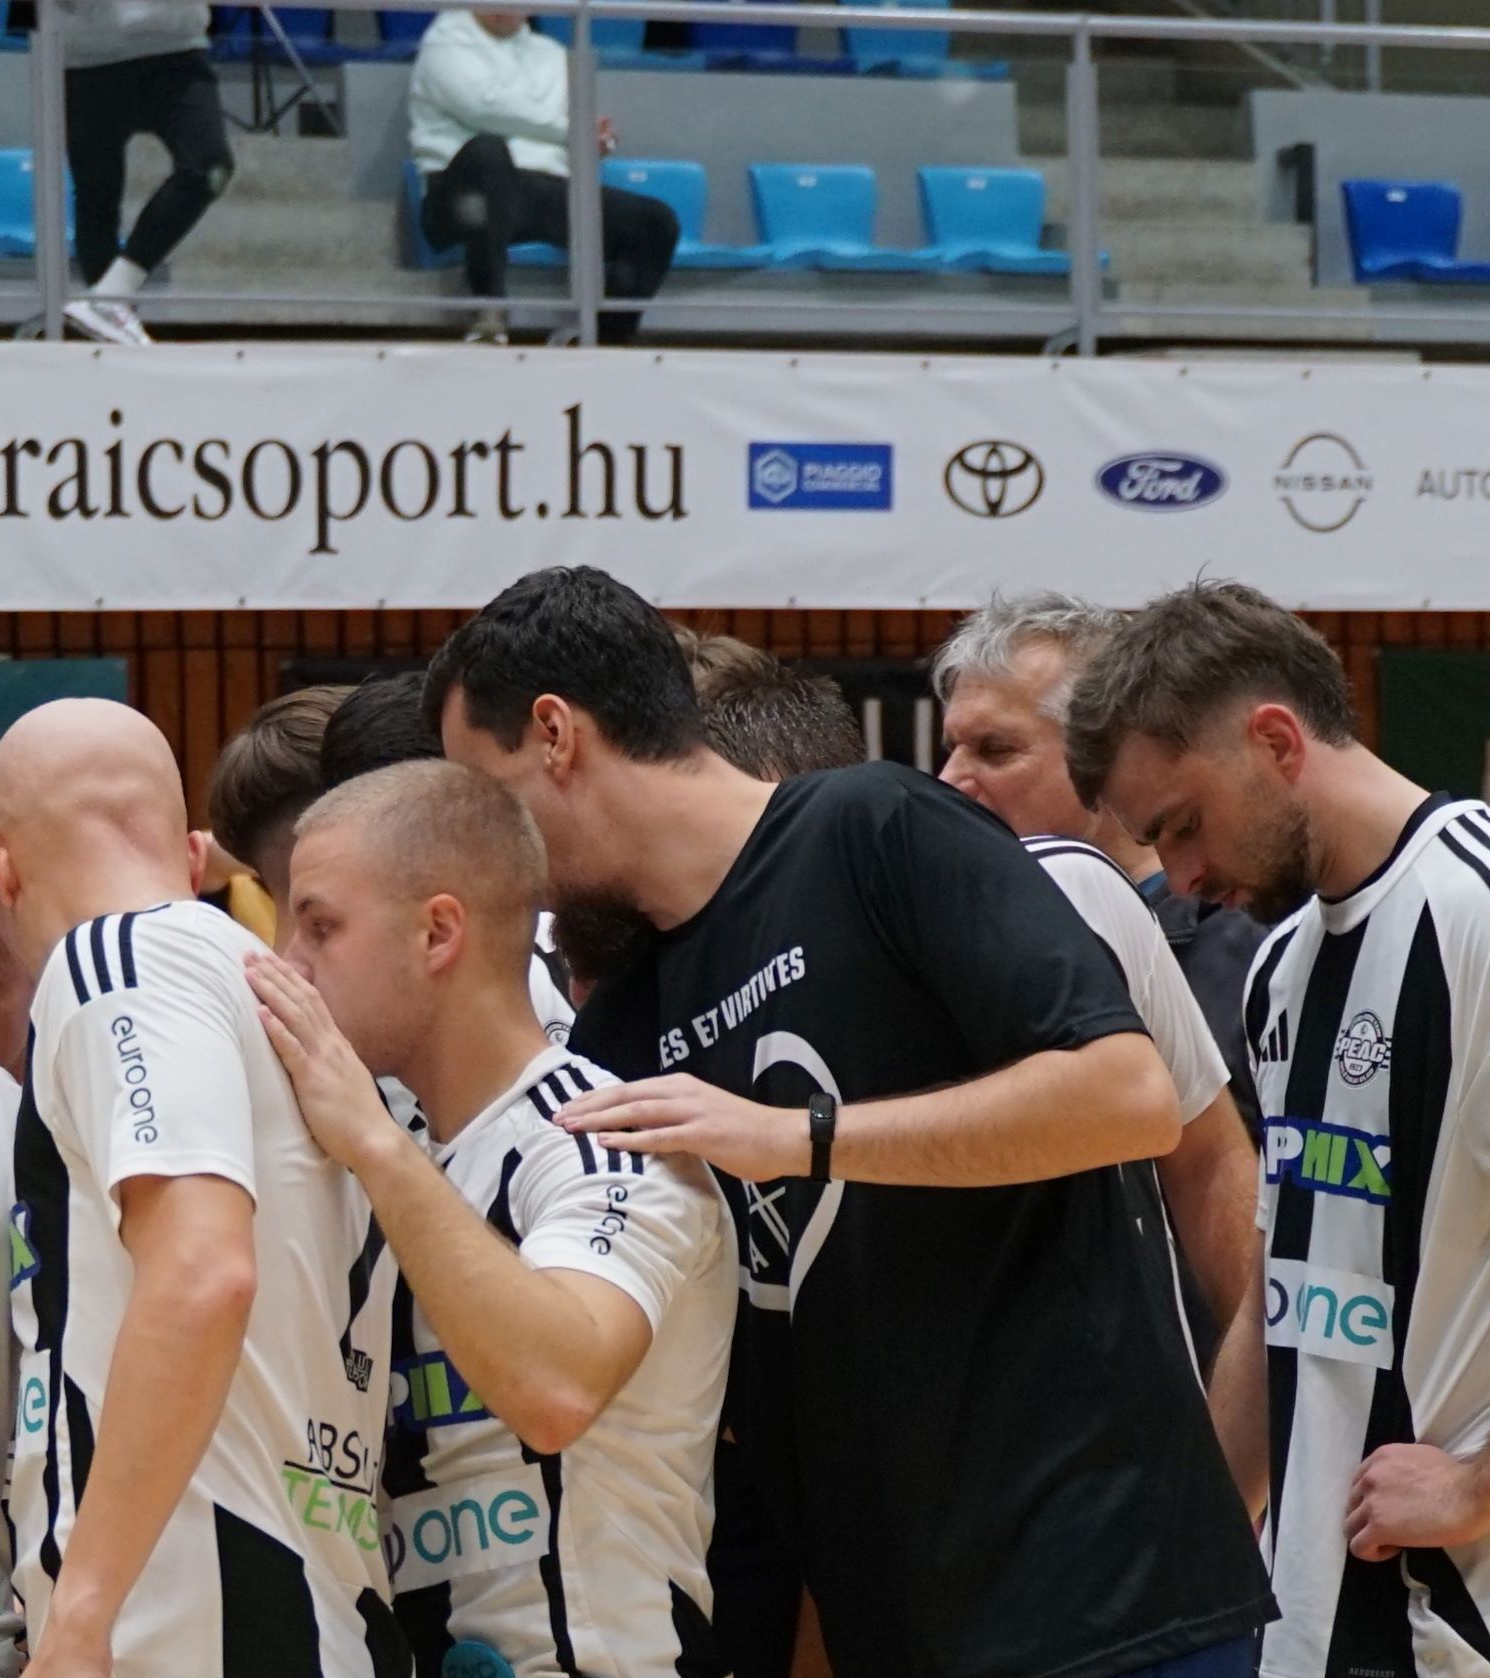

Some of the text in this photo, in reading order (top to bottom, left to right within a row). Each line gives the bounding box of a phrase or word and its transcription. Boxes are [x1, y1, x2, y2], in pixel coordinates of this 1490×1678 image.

[1118, 461, 1202, 503] Ford
[1274, 476, 1373, 491] NISSAN
[691, 1007, 719, 1048] ET
[413, 1489, 540, 1564] one
